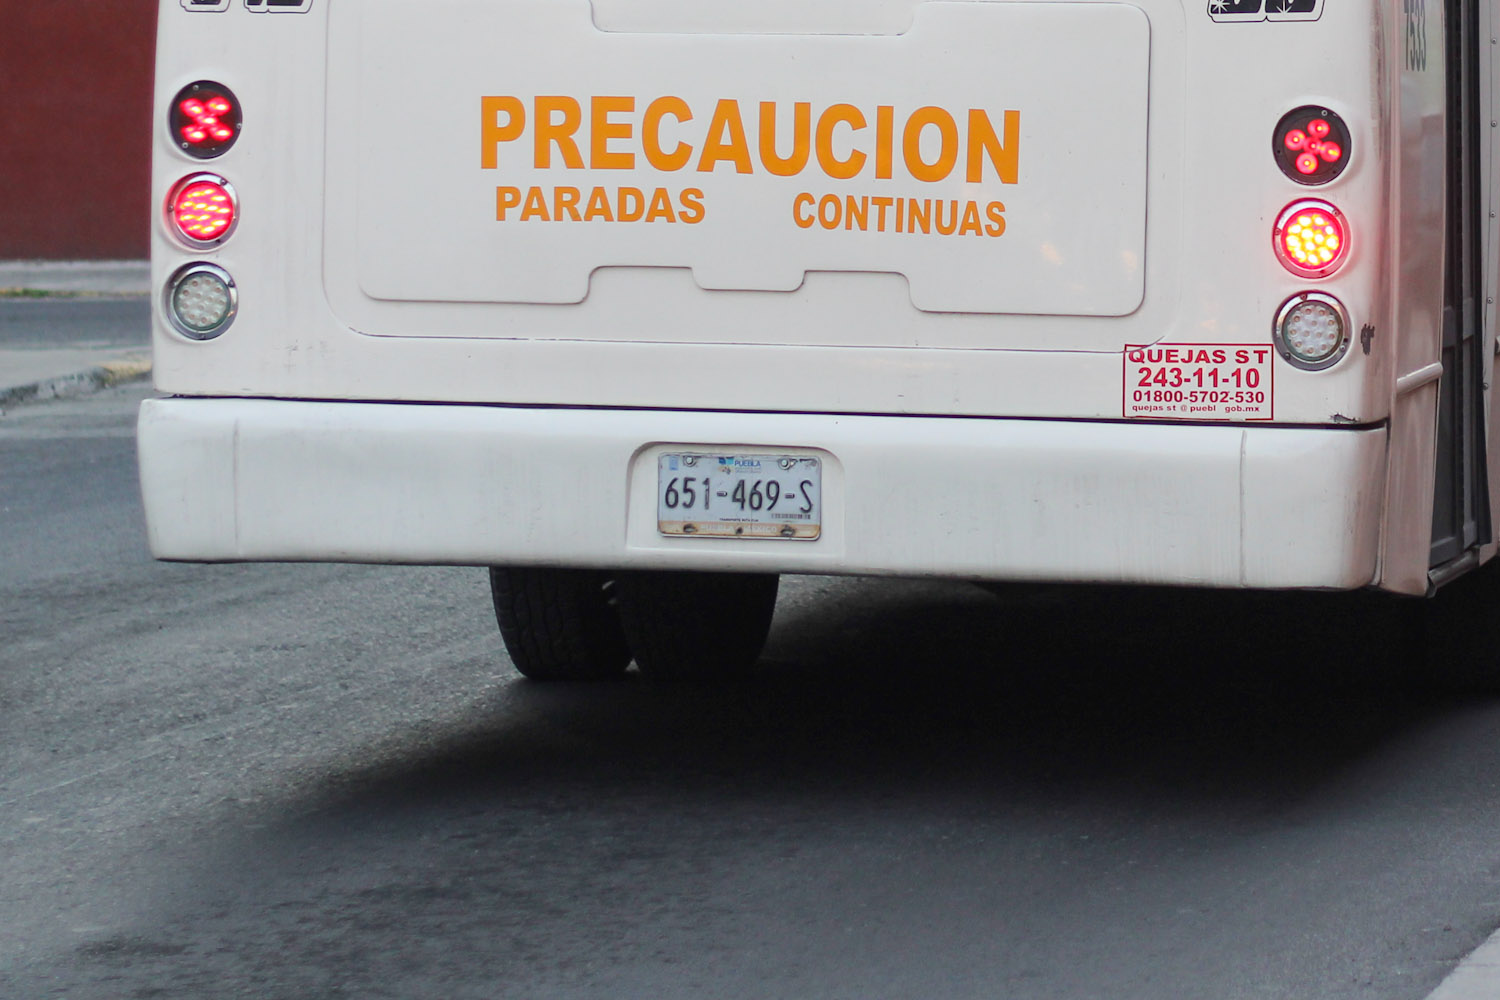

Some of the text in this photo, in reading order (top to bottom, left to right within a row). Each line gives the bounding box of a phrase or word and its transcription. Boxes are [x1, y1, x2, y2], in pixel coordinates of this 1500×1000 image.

[480, 95, 1021, 185] PRECAUCION
[495, 186, 1007, 238] PARADAS CONTINUAS
[1128, 348, 1227, 364] QUEJAS
[1138, 366, 1260, 389] 243-11-10
[1132, 404, 1164, 413] quejas
[1133, 390, 1265, 404] 01800-5702-530
[664, 476, 814, 514] 651-469-S
